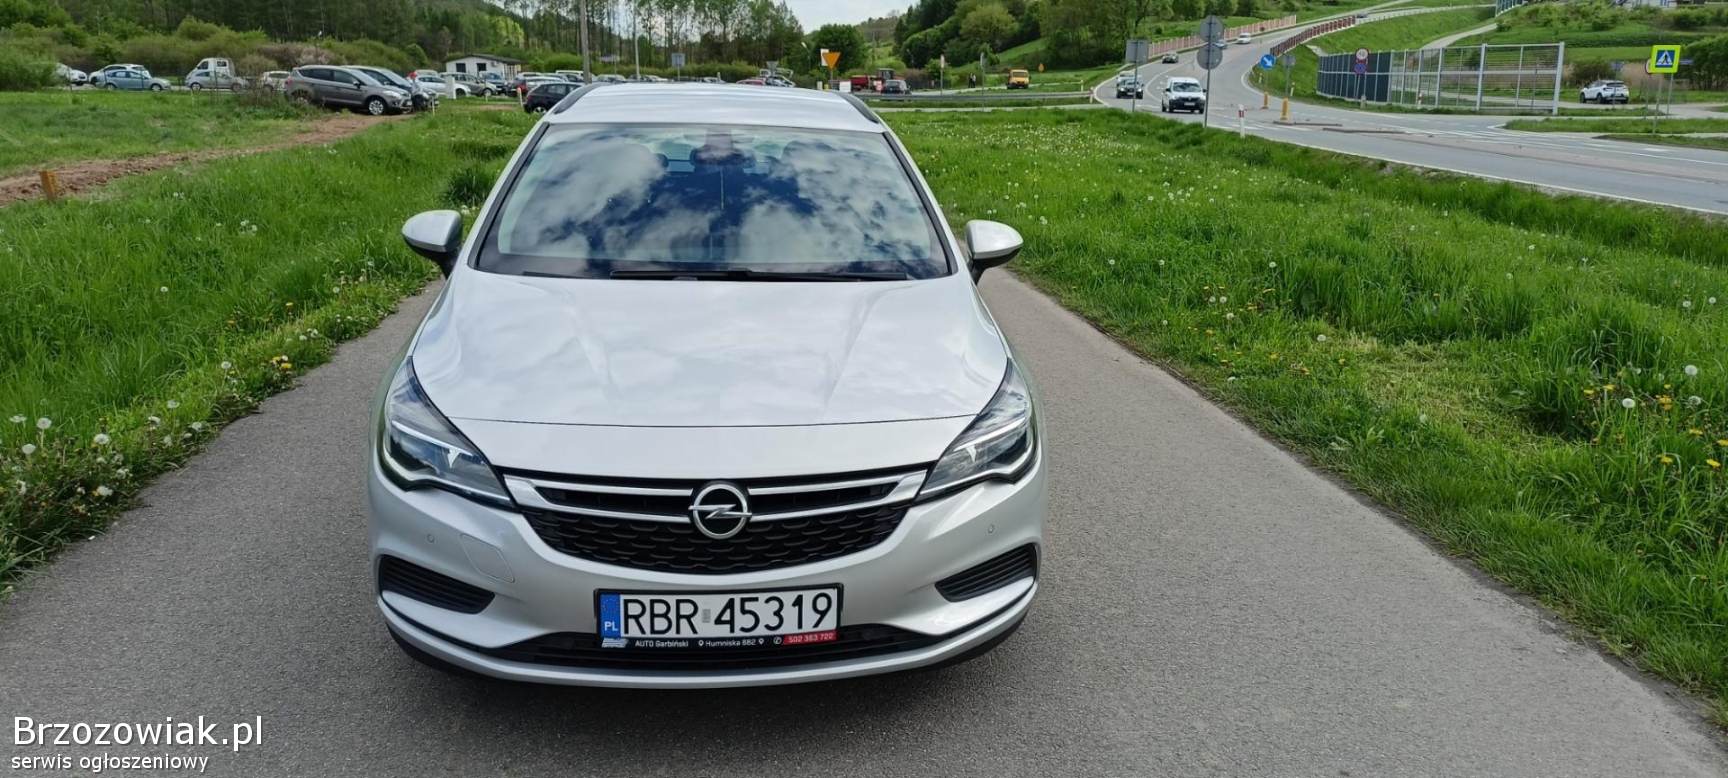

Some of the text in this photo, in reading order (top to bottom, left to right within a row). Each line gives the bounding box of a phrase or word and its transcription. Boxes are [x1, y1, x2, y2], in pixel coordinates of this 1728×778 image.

[623, 592, 832, 635] RBR 45319
[604, 621, 618, 631] PL
[705, 639, 741, 647] Humniska
